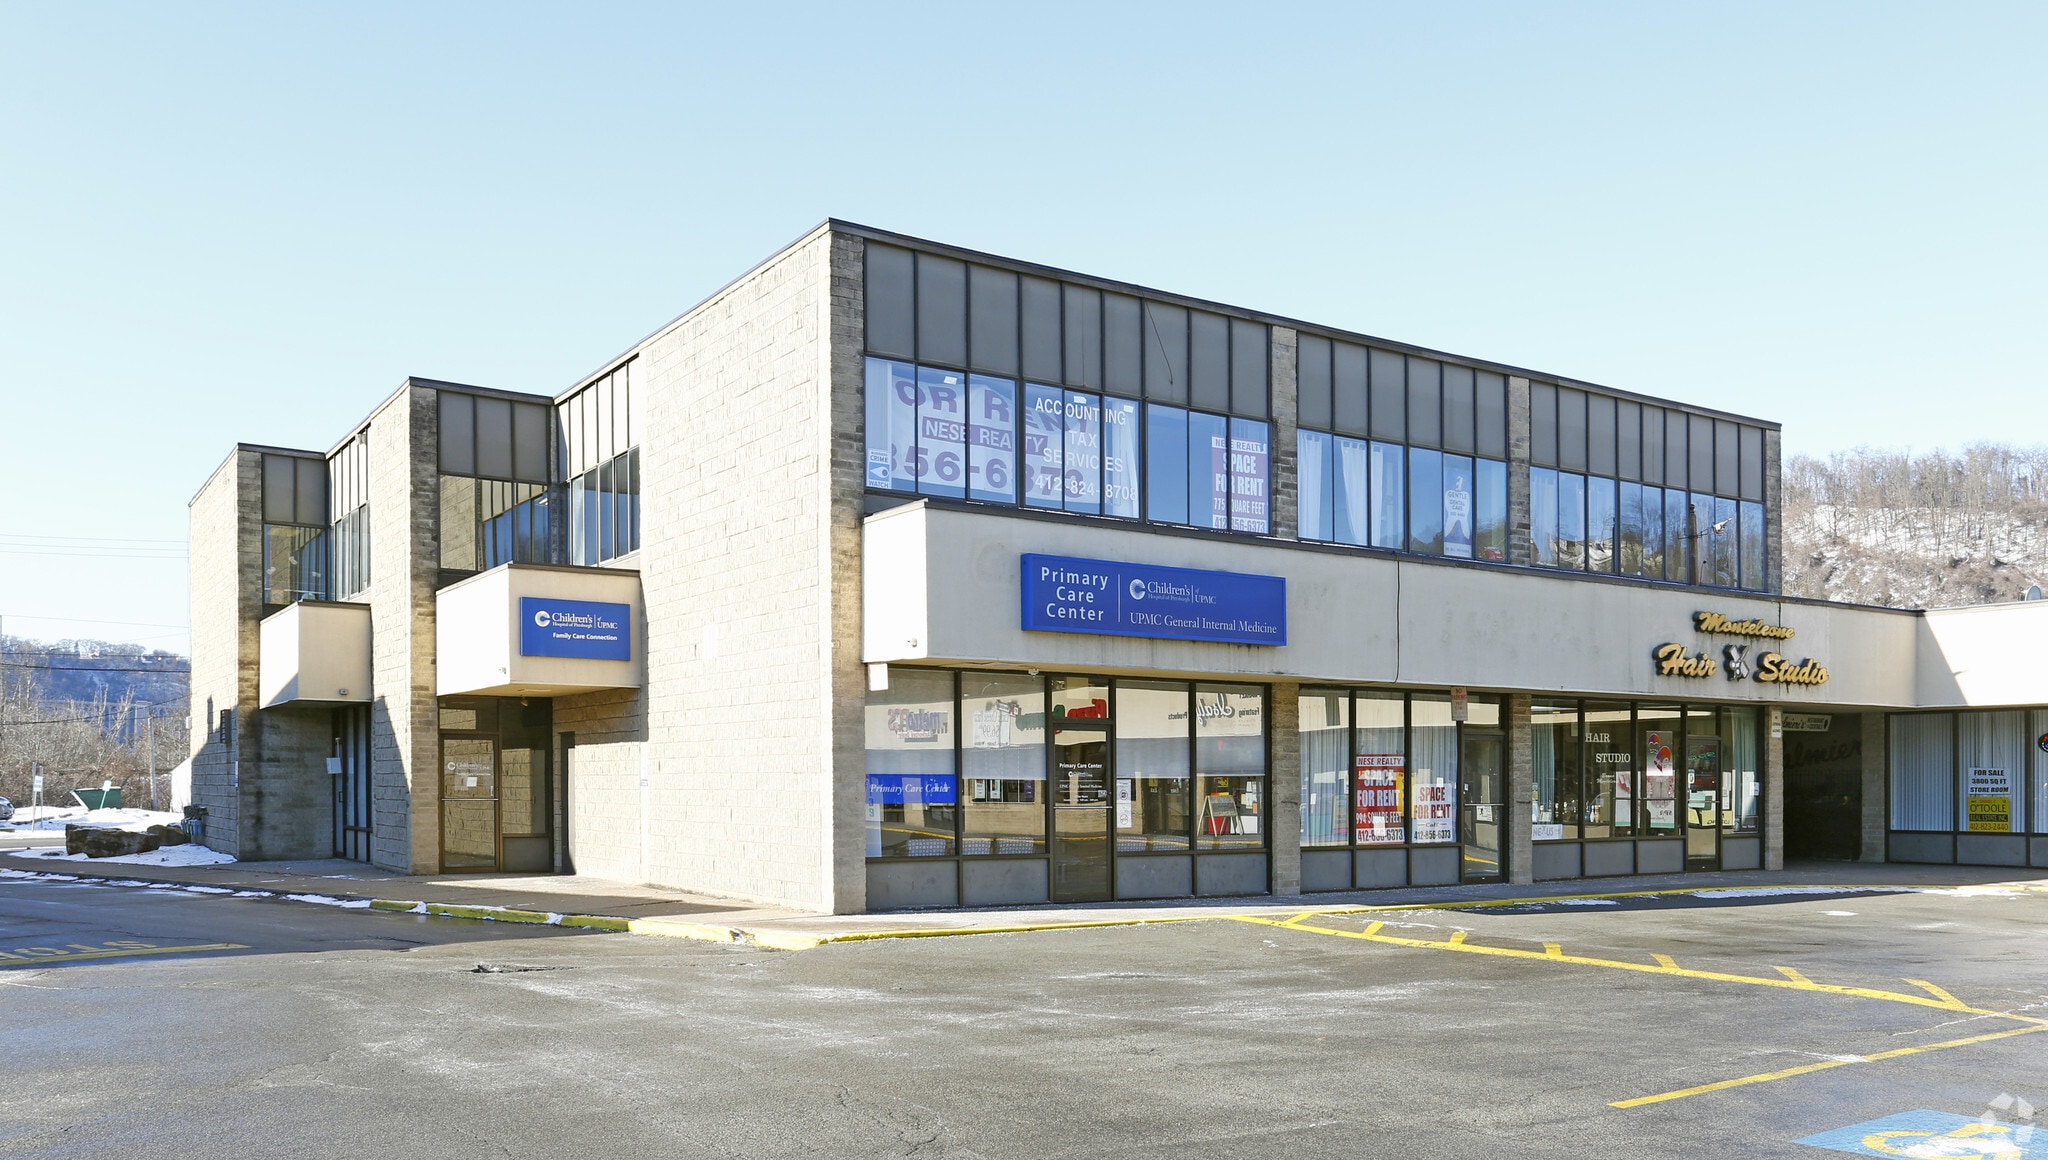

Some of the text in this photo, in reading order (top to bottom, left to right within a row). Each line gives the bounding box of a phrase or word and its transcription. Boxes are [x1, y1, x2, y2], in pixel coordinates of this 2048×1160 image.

[1035, 397, 1126, 426] ACCOUNTING
[979, 428, 1044, 453] REATY
[1068, 430, 1097, 448] TAX
[1215, 438, 1234, 448] NEE
[870, 455, 888, 463] CRIME
[1043, 447, 1123, 472] SERVICES
[868, 480, 889, 488] WATCH
[1237, 476, 1264, 496] RENT
[1448, 491, 1467, 500] GENTLE
[1214, 497, 1225, 511] 775
[1251, 501, 1265, 515] FEET
[1041, 566, 1109, 590] Primary
[1056, 586, 1094, 603] Care
[1147, 581, 1191, 596] Children's
[1195, 594, 1216, 604] UPMC
[552, 612, 593, 623] Children's
[597, 621, 618, 629] UPMC
[1046, 603, 1104, 622] Center
[1130, 612, 1277, 634] UPMC General Internal Medicine
[1695, 611, 1795, 639] Monteleone
[552, 632, 618, 641] Family Care Connection
[1655, 642, 1829, 684] Hair Studio
[1585, 733, 1610, 743] HAIR
[1595, 753, 1631, 763] STUDIO
[1364, 769, 1394, 787] SPACE
[870, 784, 951, 795] Primary Care Center
[1420, 787, 1445, 801] SPACE
[1357, 790, 1400, 807] FOR RENT
[1390, 811, 1402, 823] FEET
[1414, 804, 1451, 819] FOR RENT
[1970, 804, 2007, 813] O'TOOLE
